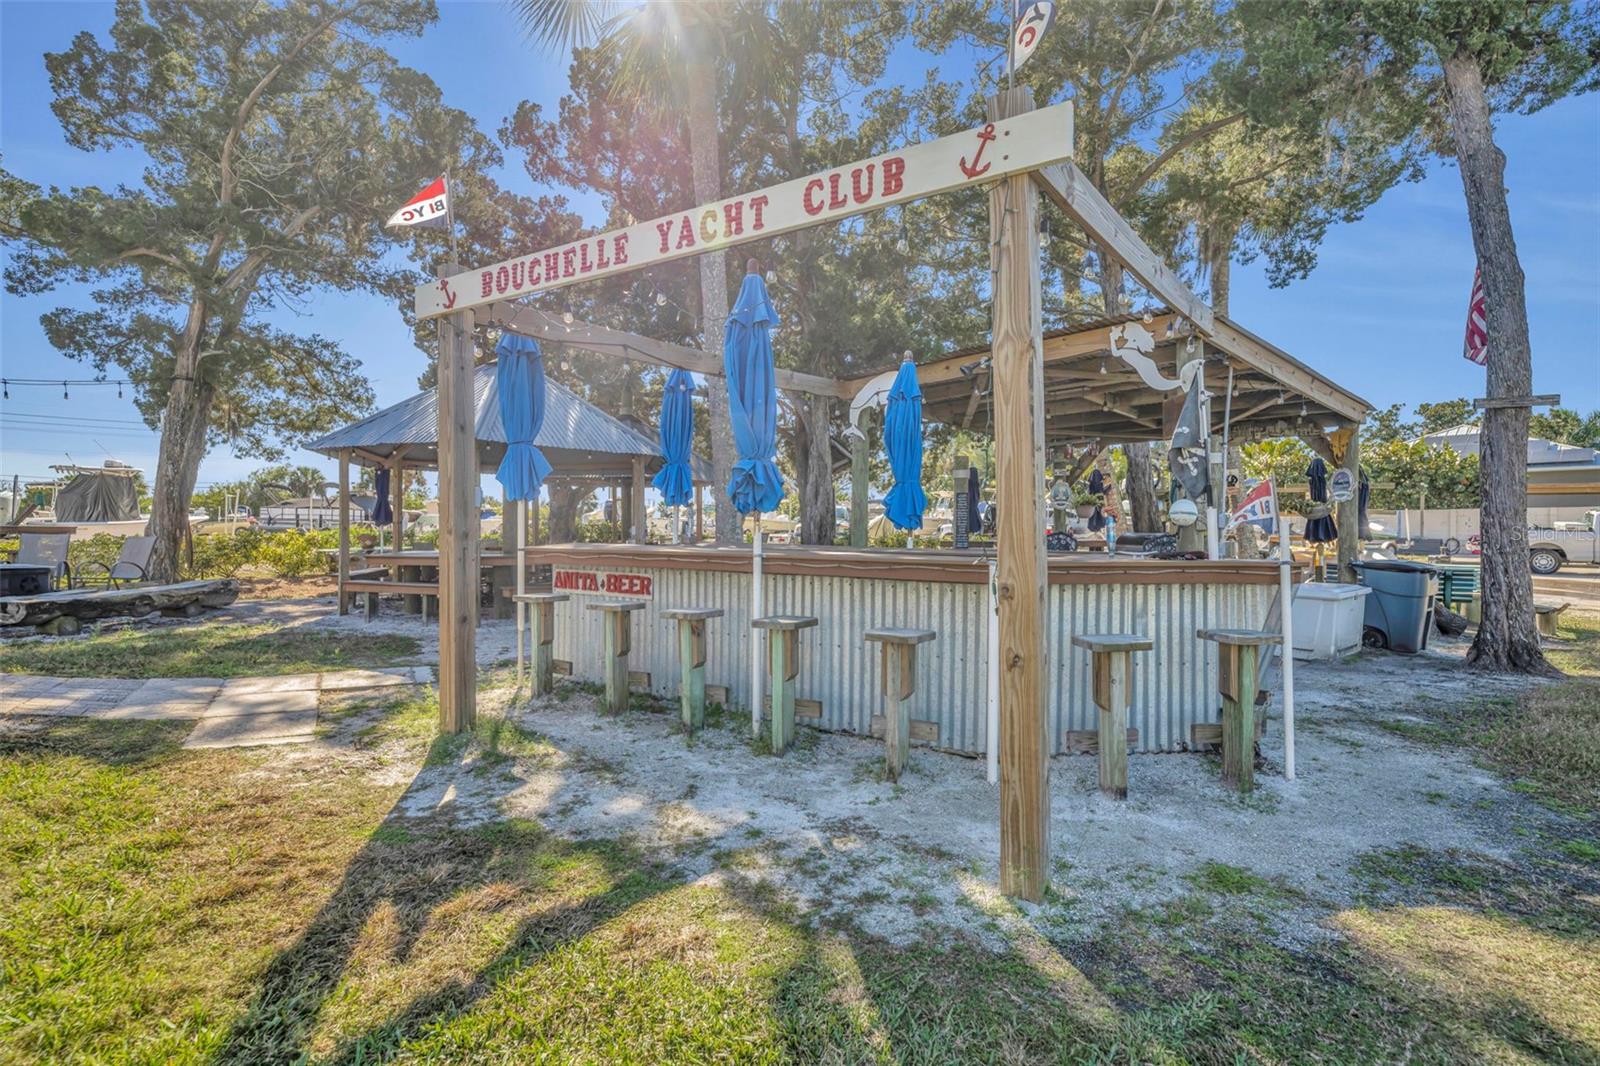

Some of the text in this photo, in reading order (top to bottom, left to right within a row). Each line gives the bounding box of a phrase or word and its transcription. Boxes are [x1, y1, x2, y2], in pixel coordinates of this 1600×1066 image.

[481, 157, 906, 298] BOUCHELLE YACHT CLUB
[554, 571, 652, 596] ANITA BEER
